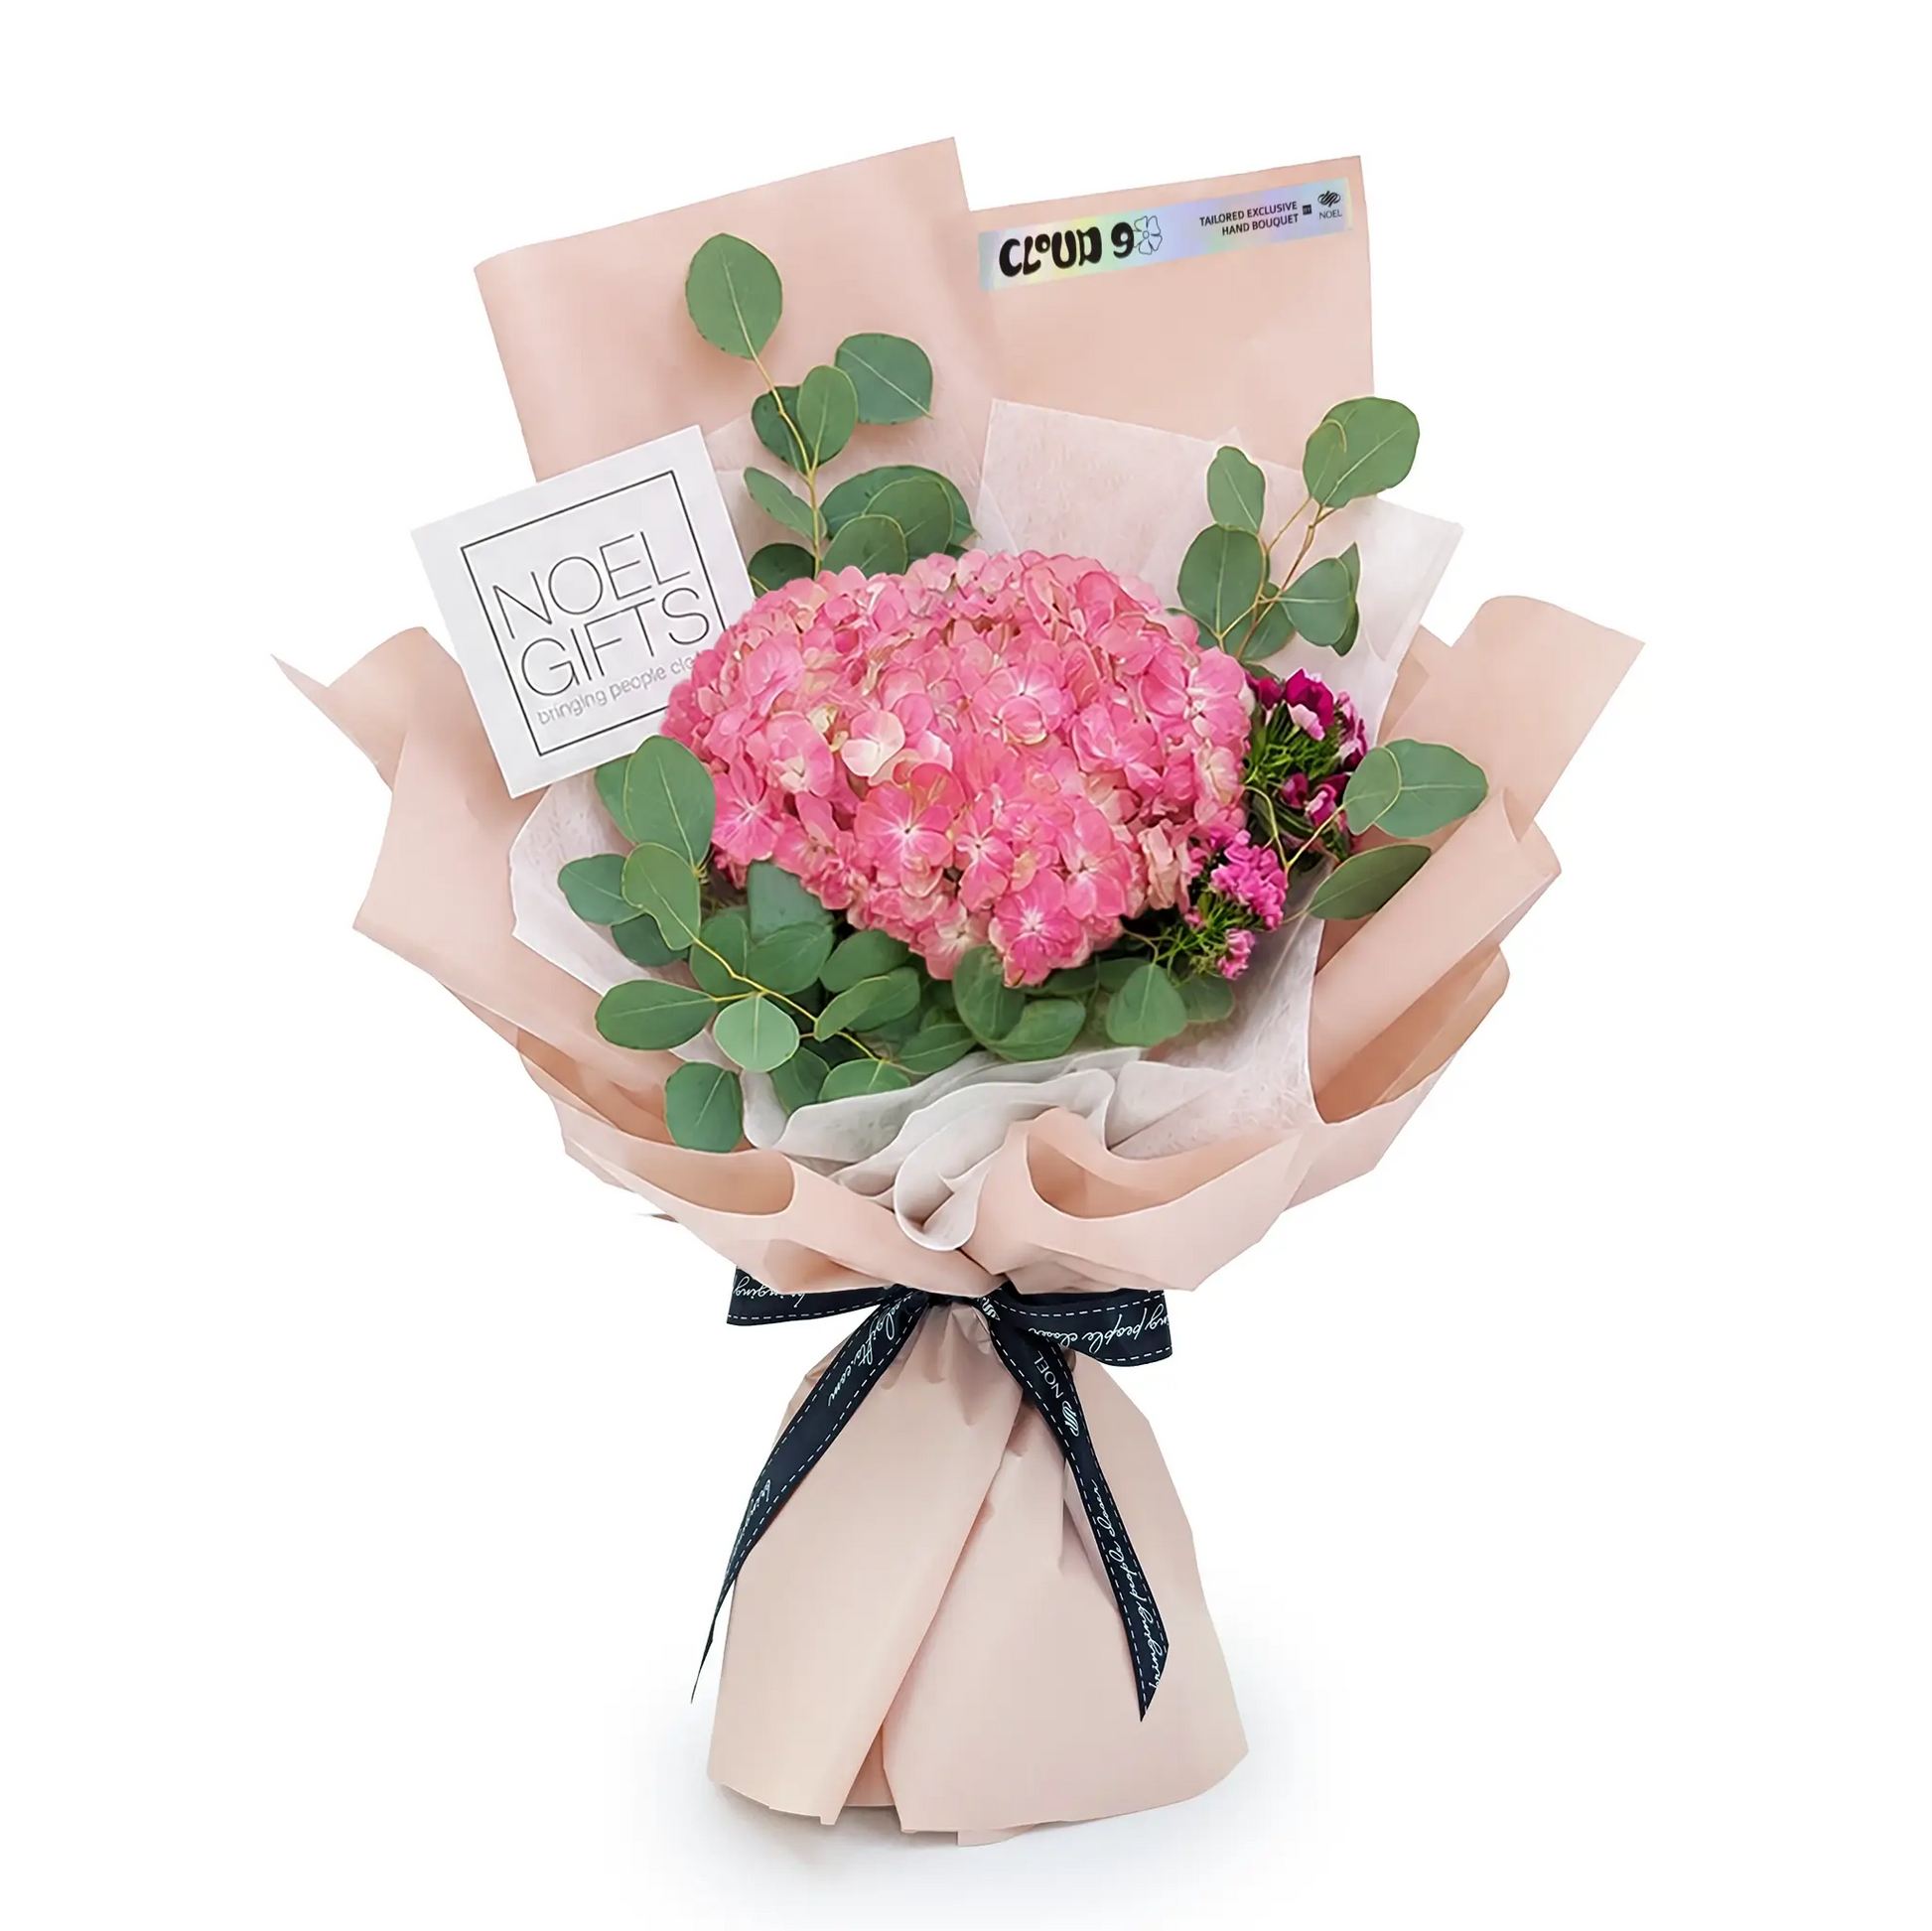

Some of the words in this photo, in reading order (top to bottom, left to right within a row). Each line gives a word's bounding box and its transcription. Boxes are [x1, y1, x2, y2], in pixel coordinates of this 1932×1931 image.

[1199, 210, 1245, 227] TAILORED
[1247, 201, 1298, 218] EXCLUSIVE
[1222, 222, 1250, 236] HAND
[1252, 212, 1299, 231] BOUQUET
[1318, 208, 1343, 219] NOEL
[999, 226, 1102, 277] CLOUD
[1110, 221, 1135, 259] 9
[491, 530, 691, 639] NOEL
[520, 587, 710, 697] GIFTS
[537, 692, 609, 726] bringing
[609, 665, 667, 701] people
[1029, 1327, 1078, 1348] closer
[1081, 1307, 1148, 1354] people
[1034, 1350, 1064, 1399] NOEL
[1091, 1478, 1116, 1538] closer
[1108, 1540, 1147, 1602] people
